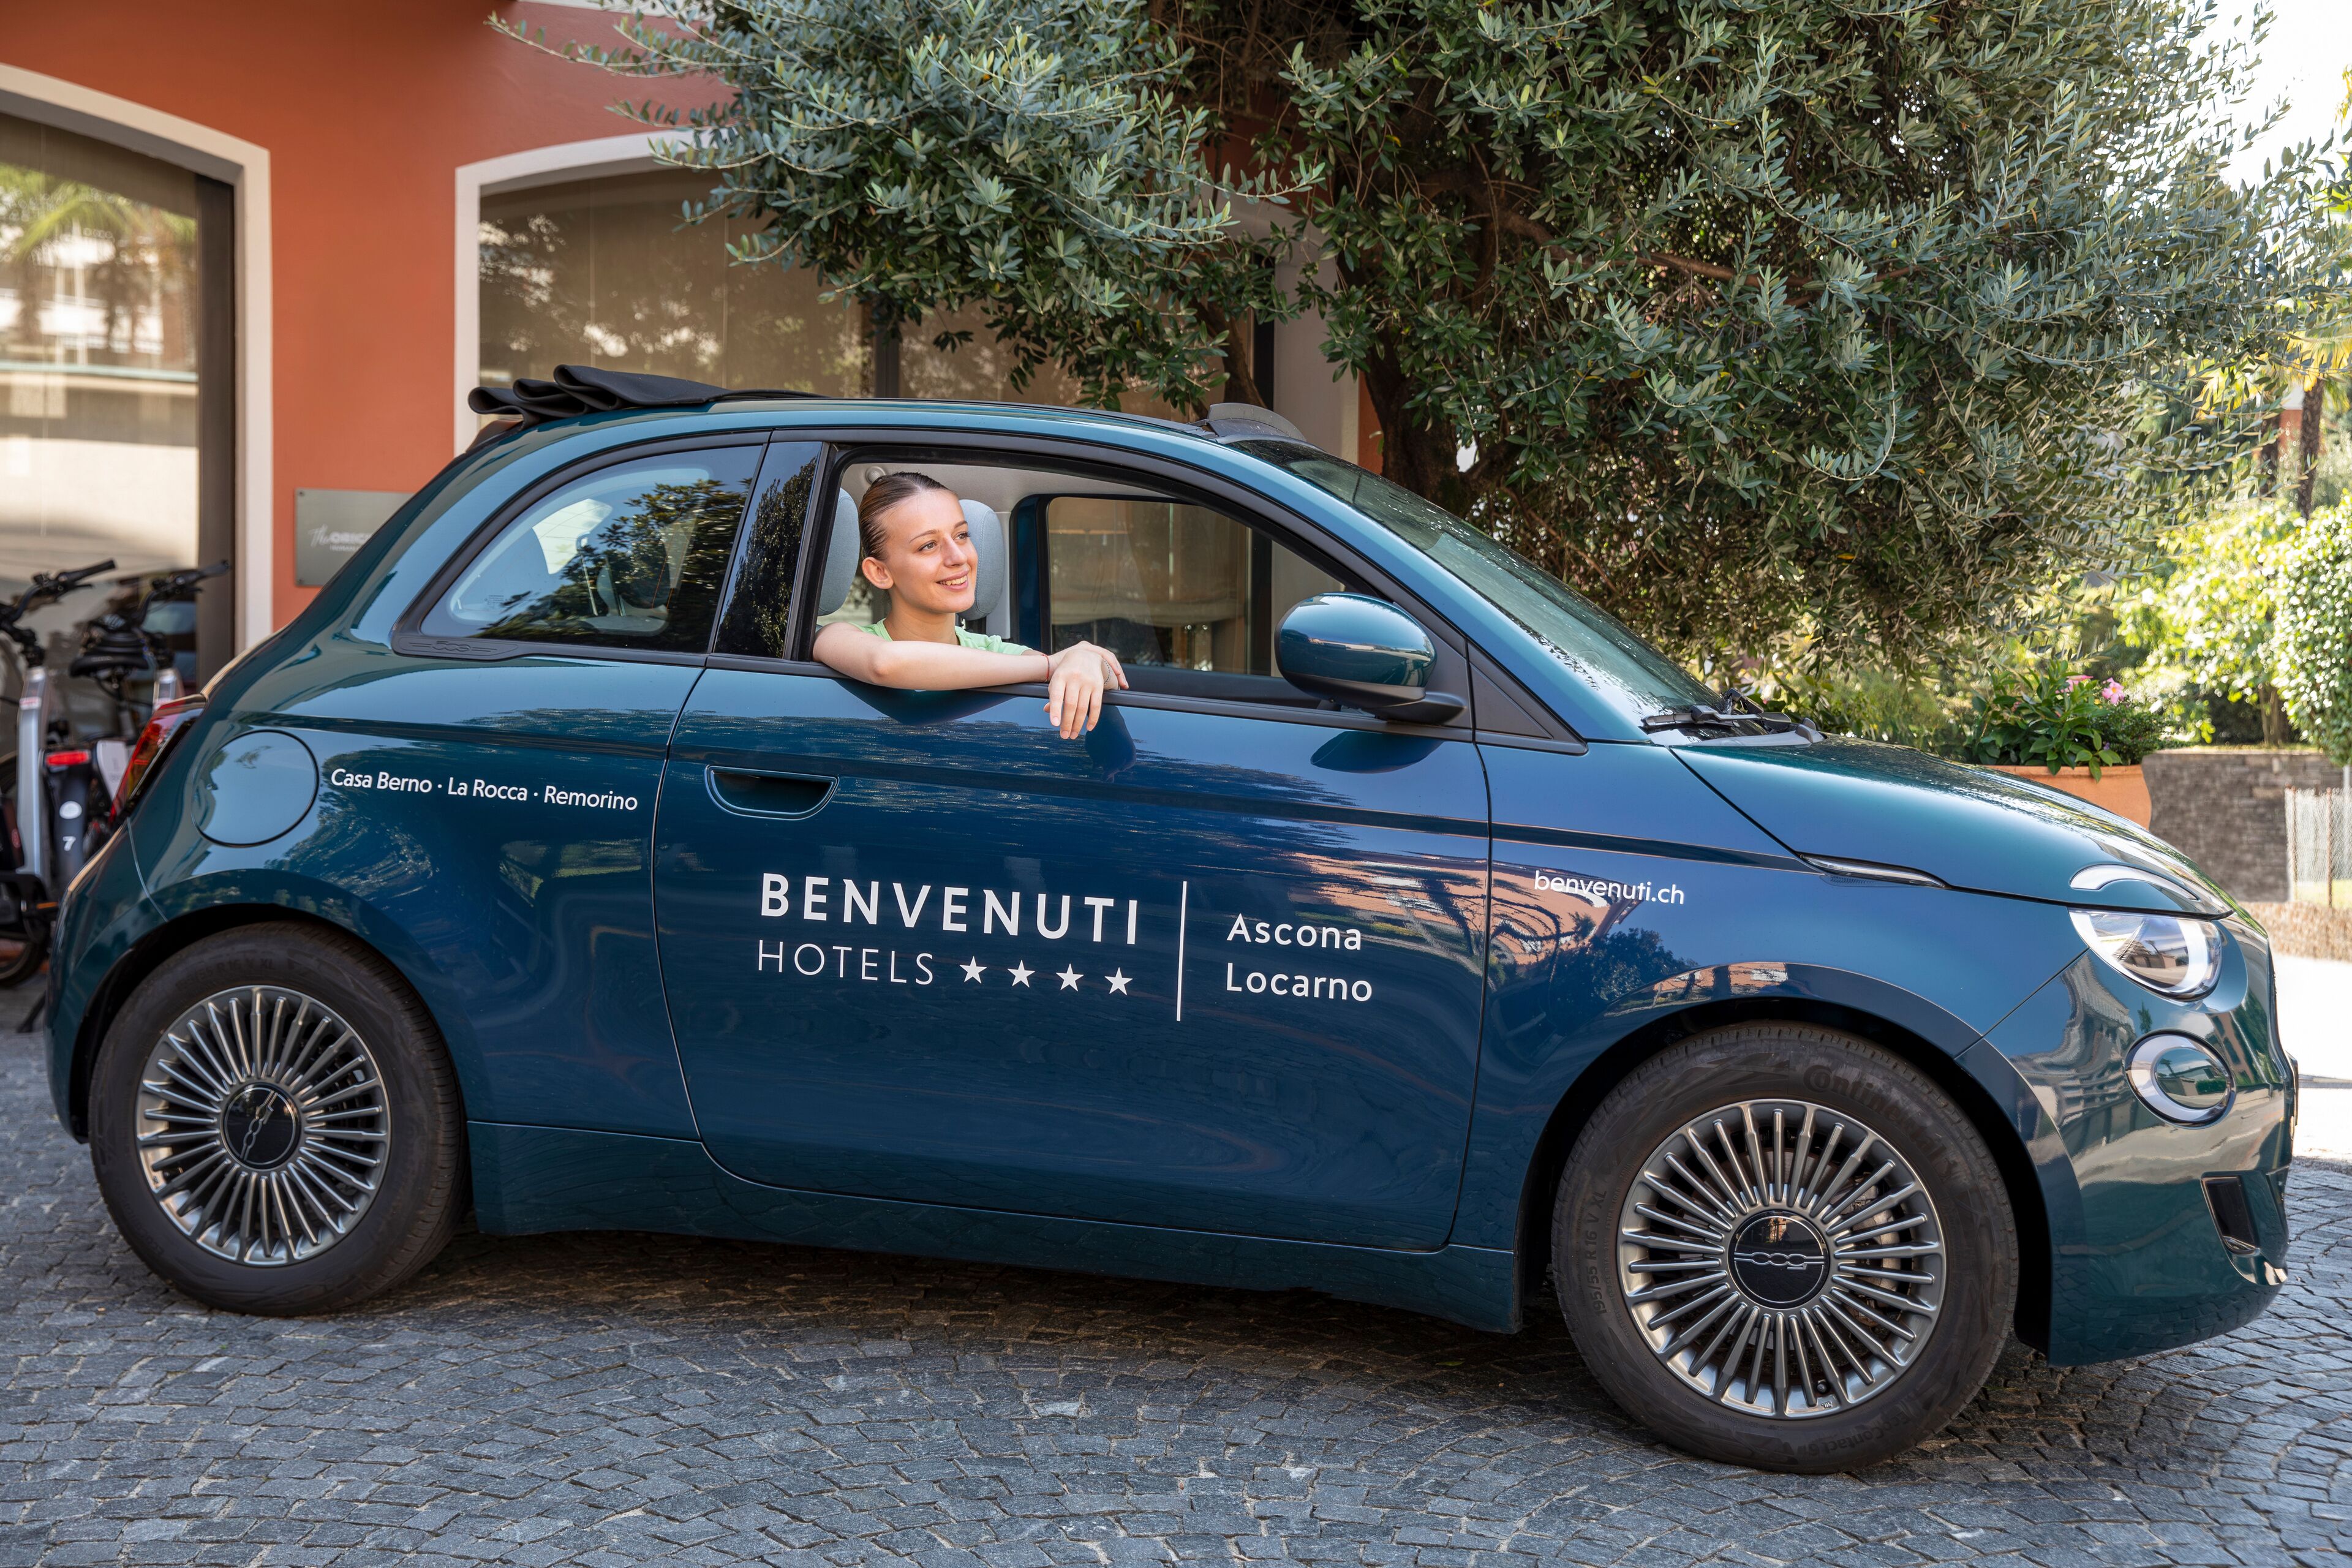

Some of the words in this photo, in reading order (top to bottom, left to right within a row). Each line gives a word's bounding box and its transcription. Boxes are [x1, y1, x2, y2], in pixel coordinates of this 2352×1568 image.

[331, 768, 373, 788] Casa
[377, 771, 432, 793] Berno
[448, 777, 468, 796] La
[472, 779, 527, 801] Rocca
[544, 785, 638, 810] Remorino
[62, 835, 77, 851] 7
[1534, 870, 1684, 905] benvenuti.ch
[761, 873, 1137, 944] BENVENUTI
[1226, 913, 1361, 951] Ascona
[758, 940, 933, 985] HOTELS
[1226, 962, 1372, 1001] Locarno
[1803, 1065, 1947, 1163] Continental
[1587, 1212, 1600, 1223] V
[1591, 1190, 1608, 1209] XL
[1585, 1230, 1597, 1246] 16
[1586, 1250, 1597, 1260] R
[1586, 1266, 1608, 1317] 195/55
